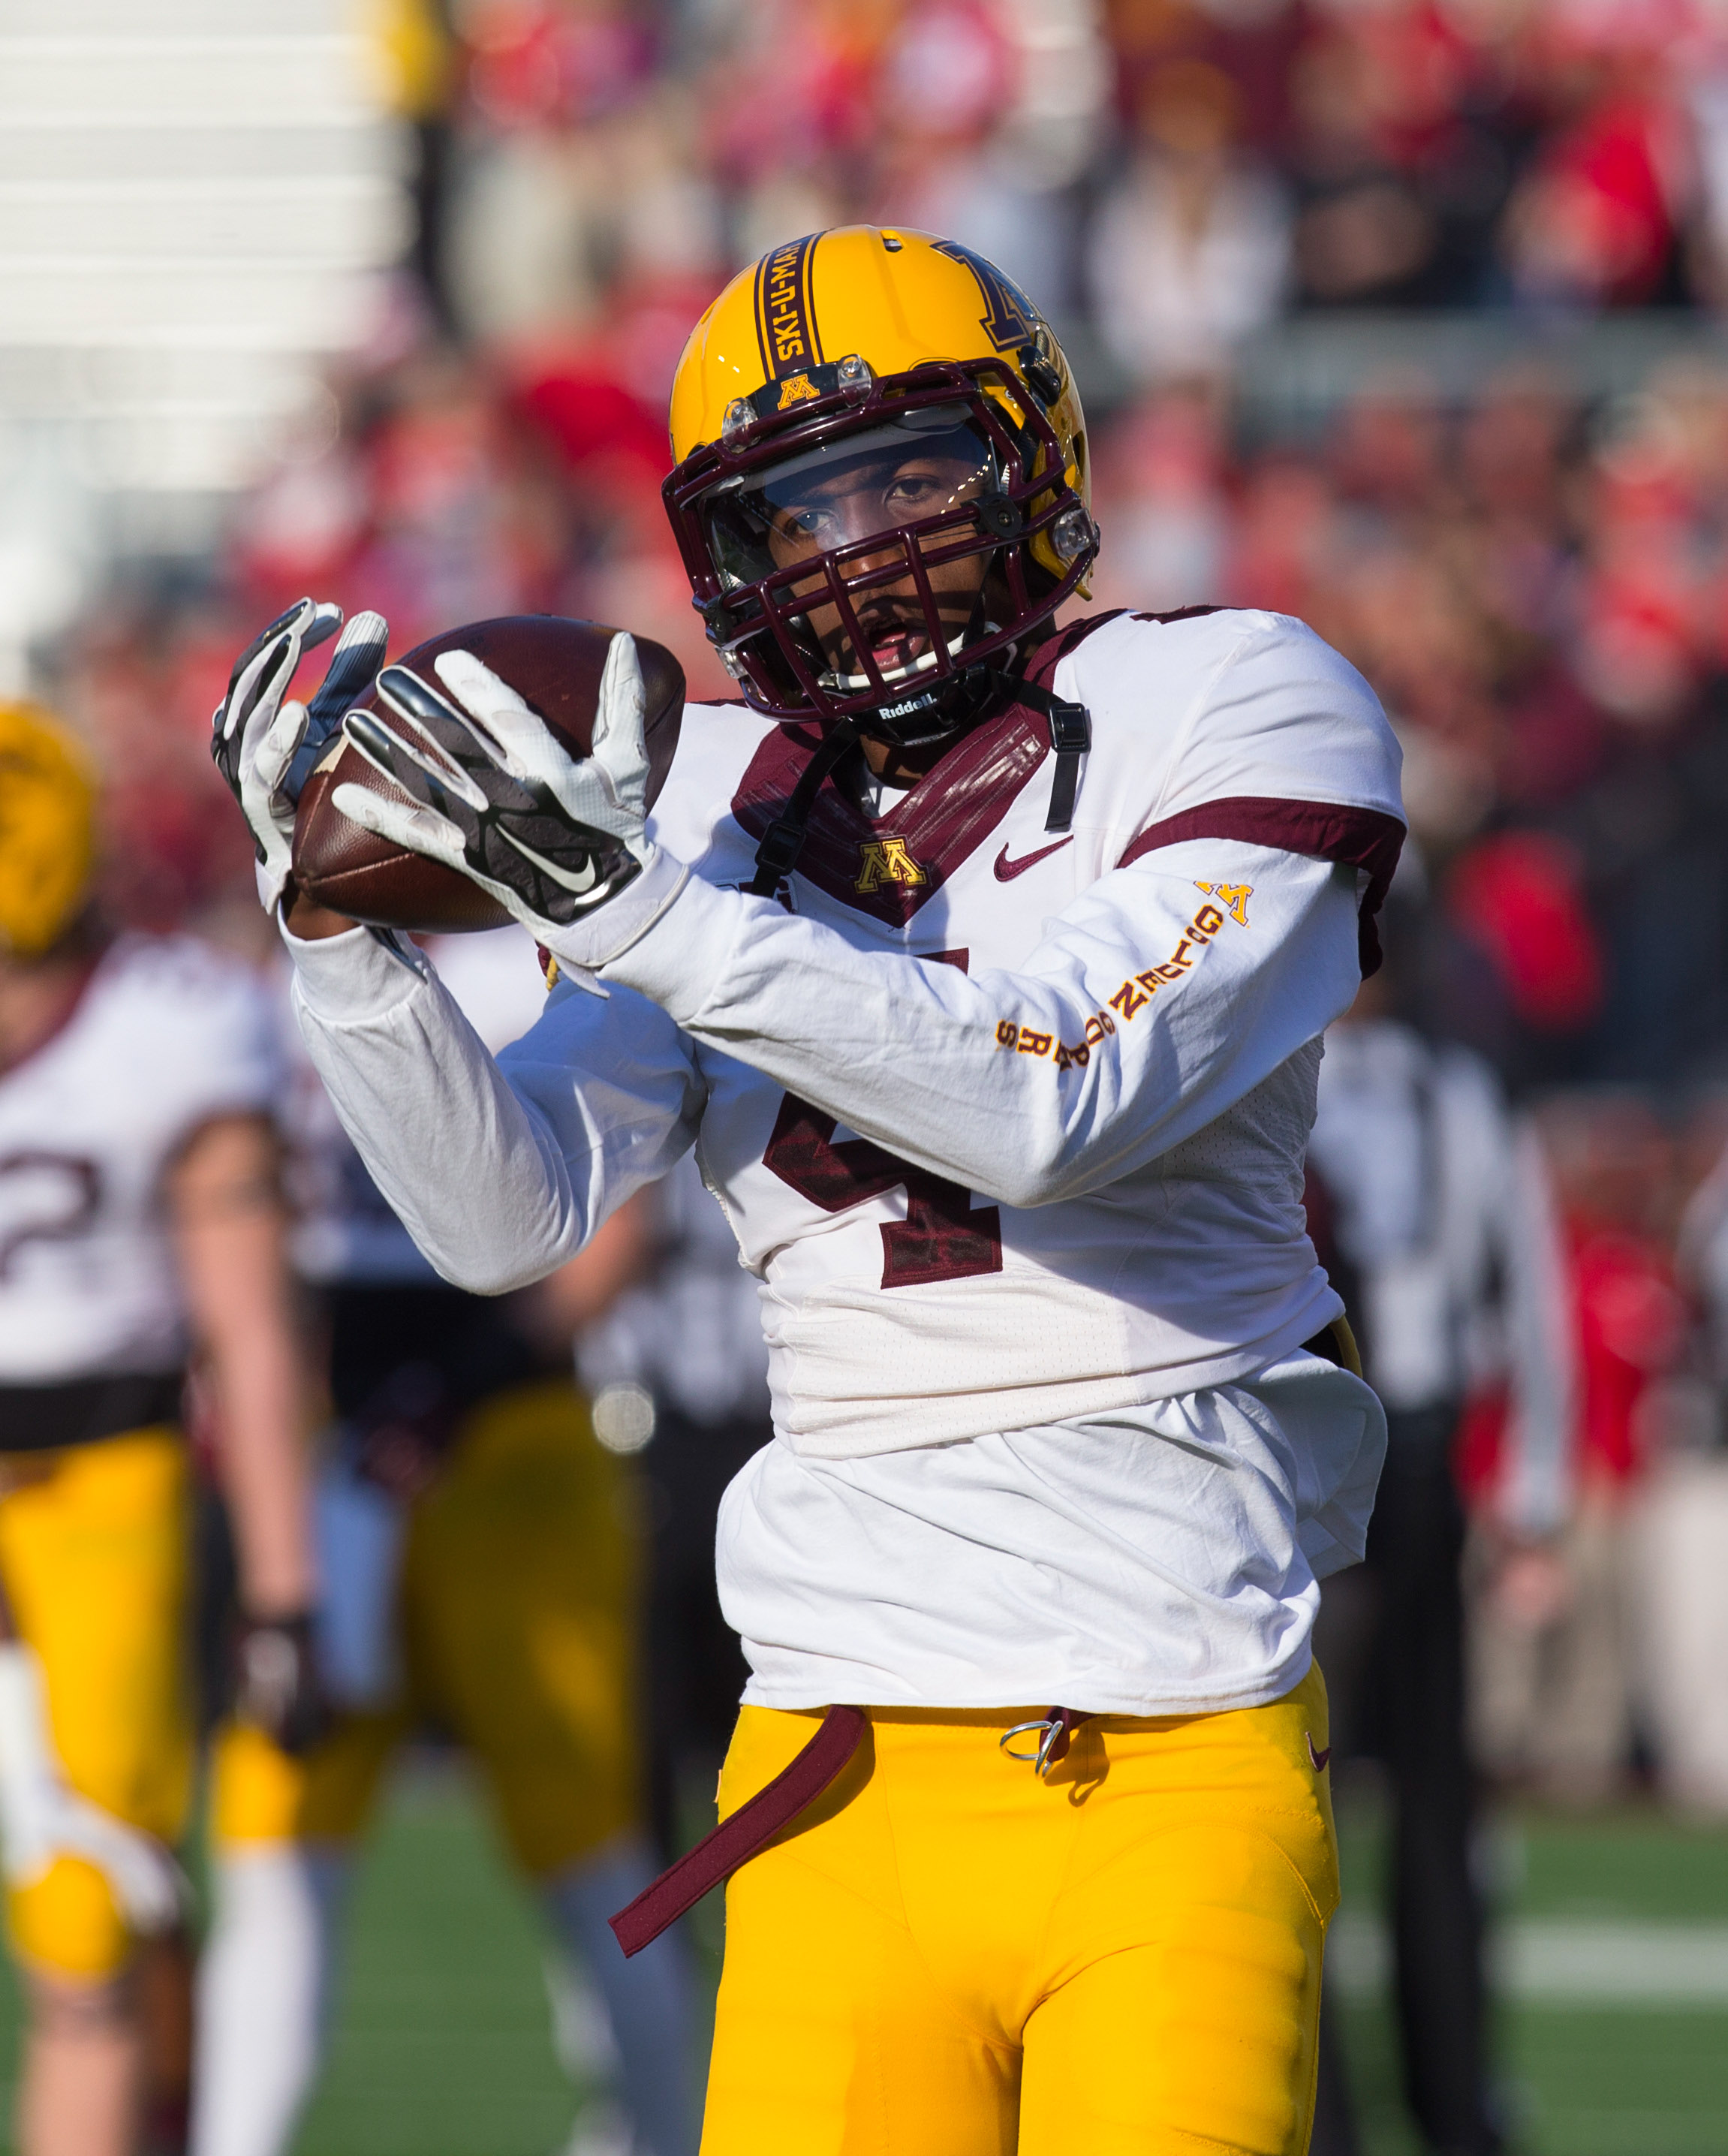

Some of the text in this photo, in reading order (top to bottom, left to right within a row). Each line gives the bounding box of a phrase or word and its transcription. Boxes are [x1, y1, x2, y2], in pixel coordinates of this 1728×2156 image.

[770, 242, 805, 363] SKI-U-MAH
[777, 372, 820, 411] M
[854, 839, 927, 894] M
[995, 1010, 1116, 1072] GOPRS
